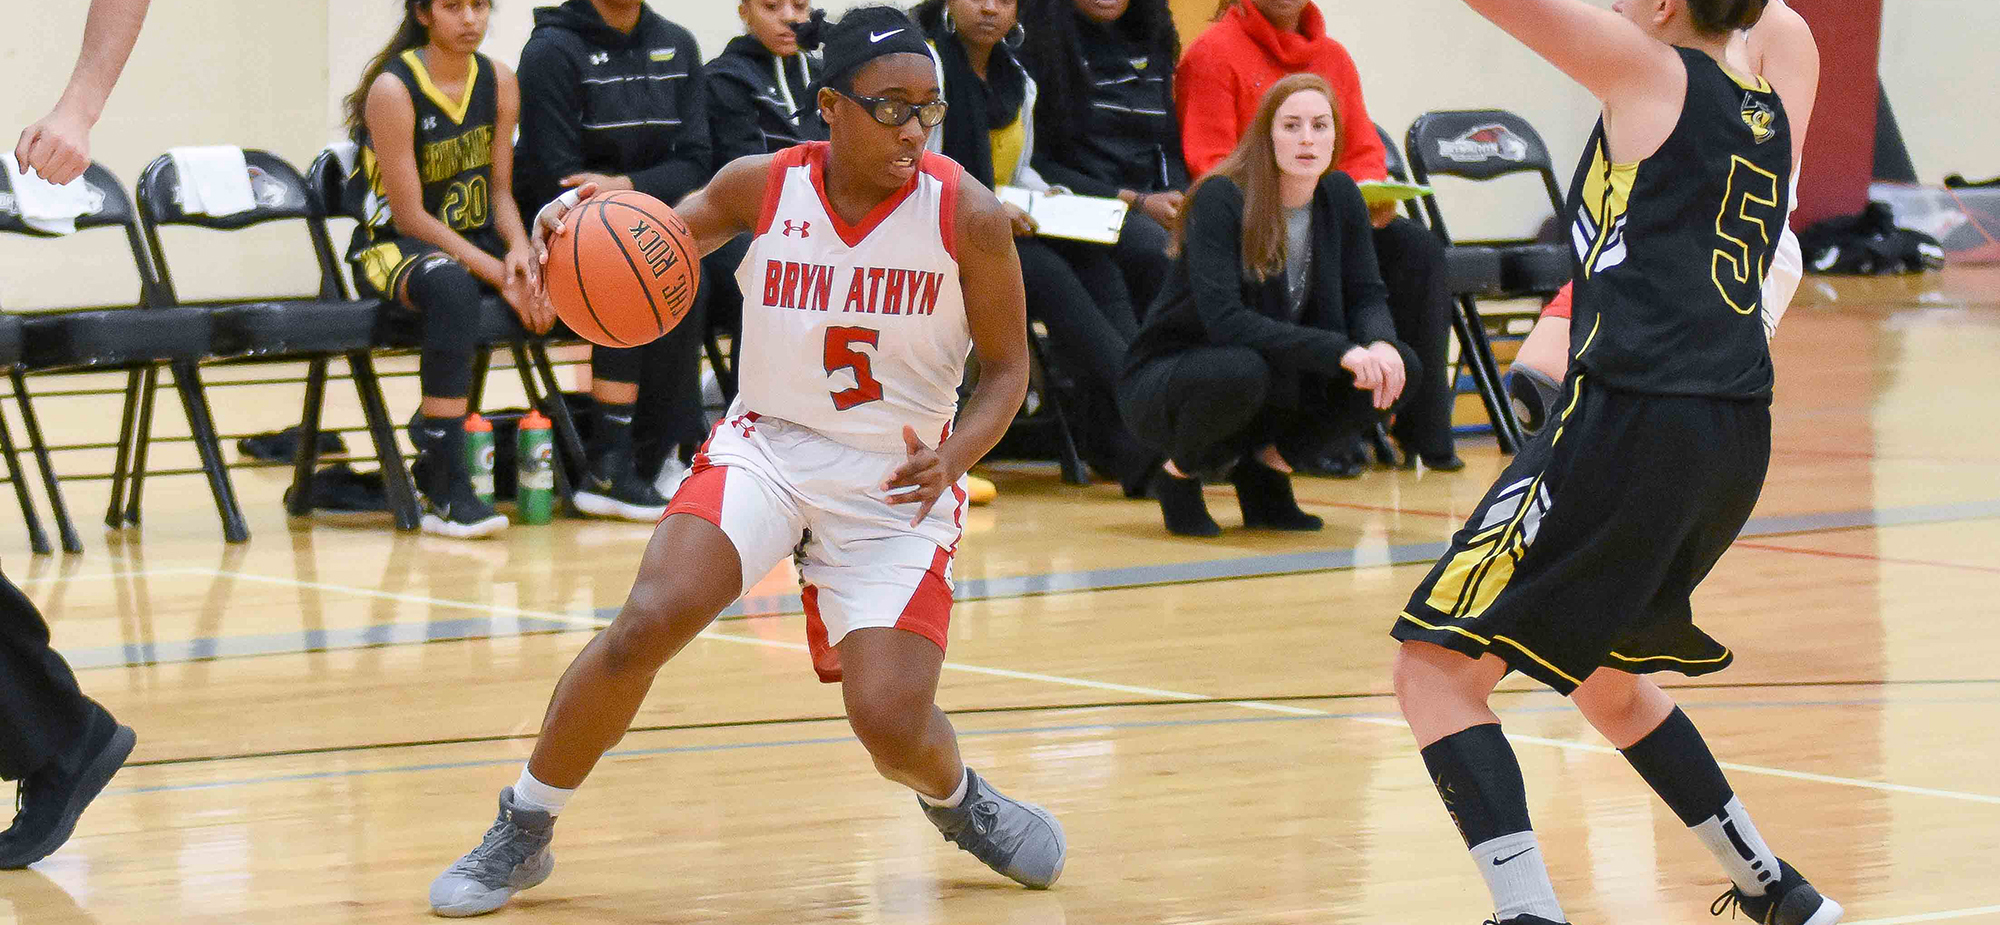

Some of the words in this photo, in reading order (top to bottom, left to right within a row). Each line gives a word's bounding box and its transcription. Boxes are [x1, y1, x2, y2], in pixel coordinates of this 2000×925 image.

[443, 175, 488, 229] 20
[628, 219, 679, 279] ROCK
[1711, 154, 1778, 314] 5
[661, 273, 688, 318] THE
[763, 259, 835, 311] BRYN
[842, 266, 944, 316] ATHYN
[824, 325, 884, 411] 5
